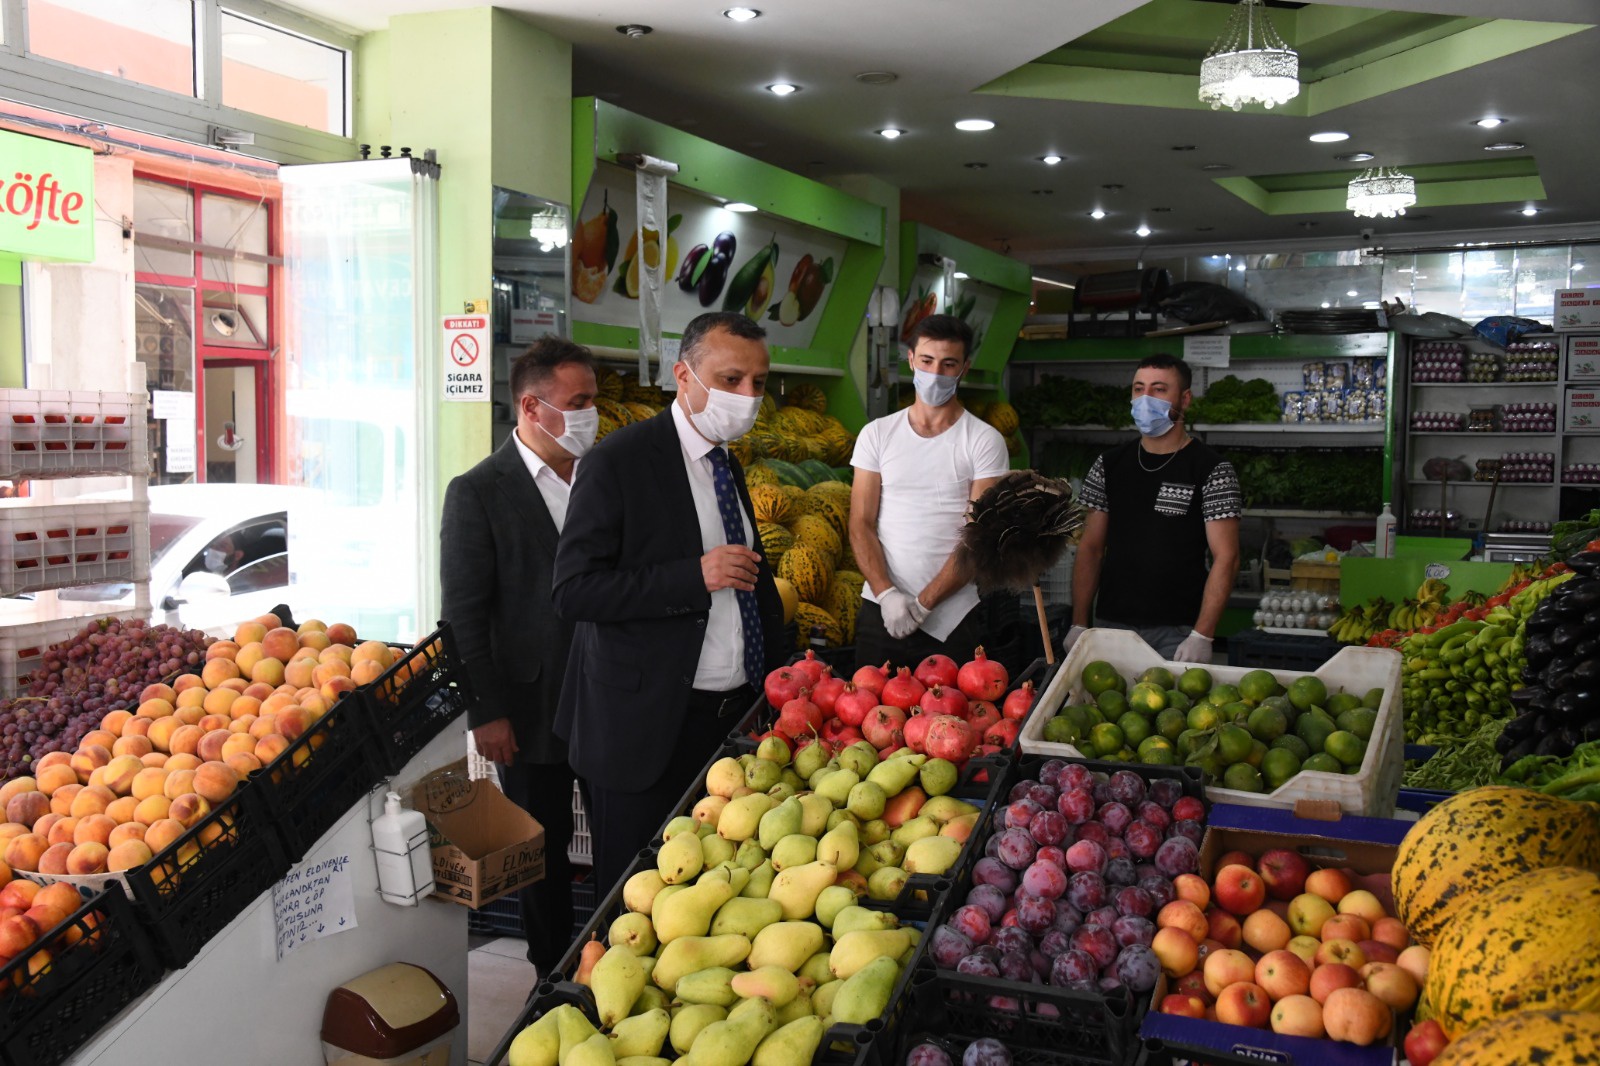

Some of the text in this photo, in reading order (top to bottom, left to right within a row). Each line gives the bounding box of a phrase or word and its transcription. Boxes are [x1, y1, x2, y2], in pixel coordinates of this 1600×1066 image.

[0, 172, 84, 230] öfte
[447, 373, 482, 382] SİGARA
[446, 385, 483, 396] İÇİLMEZ
